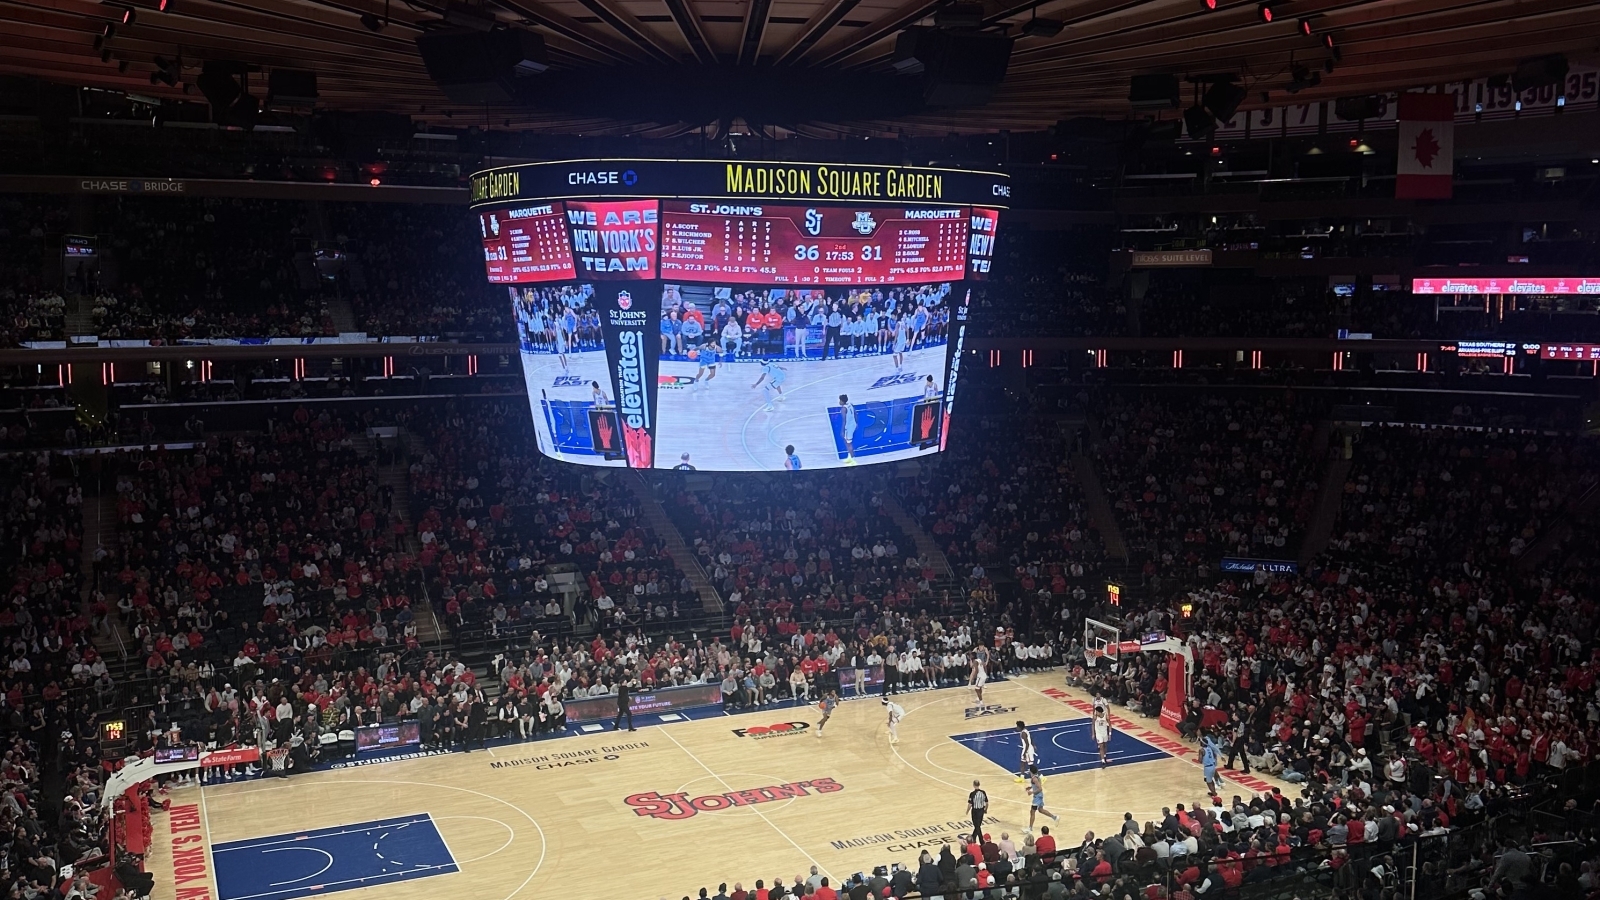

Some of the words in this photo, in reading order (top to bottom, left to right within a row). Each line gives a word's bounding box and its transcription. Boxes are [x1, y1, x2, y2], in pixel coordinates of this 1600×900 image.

[1566, 72, 1597, 100] 35
[489, 172, 519, 198] GARDEN
[569, 172, 618, 184] CHASE
[726, 164, 810, 194] MADISON
[817, 166, 881, 198] SQUARE
[887, 169, 942, 199] GARDEN
[81, 181, 127, 190] CHASE
[144, 182, 184, 192] BRIDGE
[509, 205, 552, 219] MARQUETTE
[567, 210, 597, 225] WE
[604, 209, 658, 225] ARE
[690, 204, 710, 214] ST.
[712, 205, 762, 216] JOHN'S
[905, 210, 960, 218] MARQUETTE
[972, 216, 992, 230] WE
[574, 229, 598, 252] NEW
[601, 228, 656, 254] YORK'S
[970, 234, 989, 256] NEW
[498, 246, 508, 260] 31
[794, 245, 819, 260] 36
[825, 252, 854, 260] 17:53
[861, 245, 882, 260] 31
[1135, 254, 1158, 262] infosys
[582, 257, 648, 272] TEAM
[1442, 280, 1478, 292] elevates
[1508, 280, 1546, 292] elevates
[619, 310, 646, 320] JOHN'S
[619, 331, 644, 429] elevates
[1110, 593, 1119, 606] 14
[1041, 688, 1072, 700] WE
[109, 730, 120, 740] 14
[490, 756, 549, 770] MADISON
[551, 749, 598, 761] SQUARE
[601, 741, 649, 754] GARDEN
[536, 757, 601, 770] CHASE
[169, 804, 200, 834] TEAM
[830, 834, 896, 850] MADISON
[894, 824, 949, 839] SQUARE
[887, 836, 957, 852] CHASE
[172, 835, 207, 885] YORK'S
